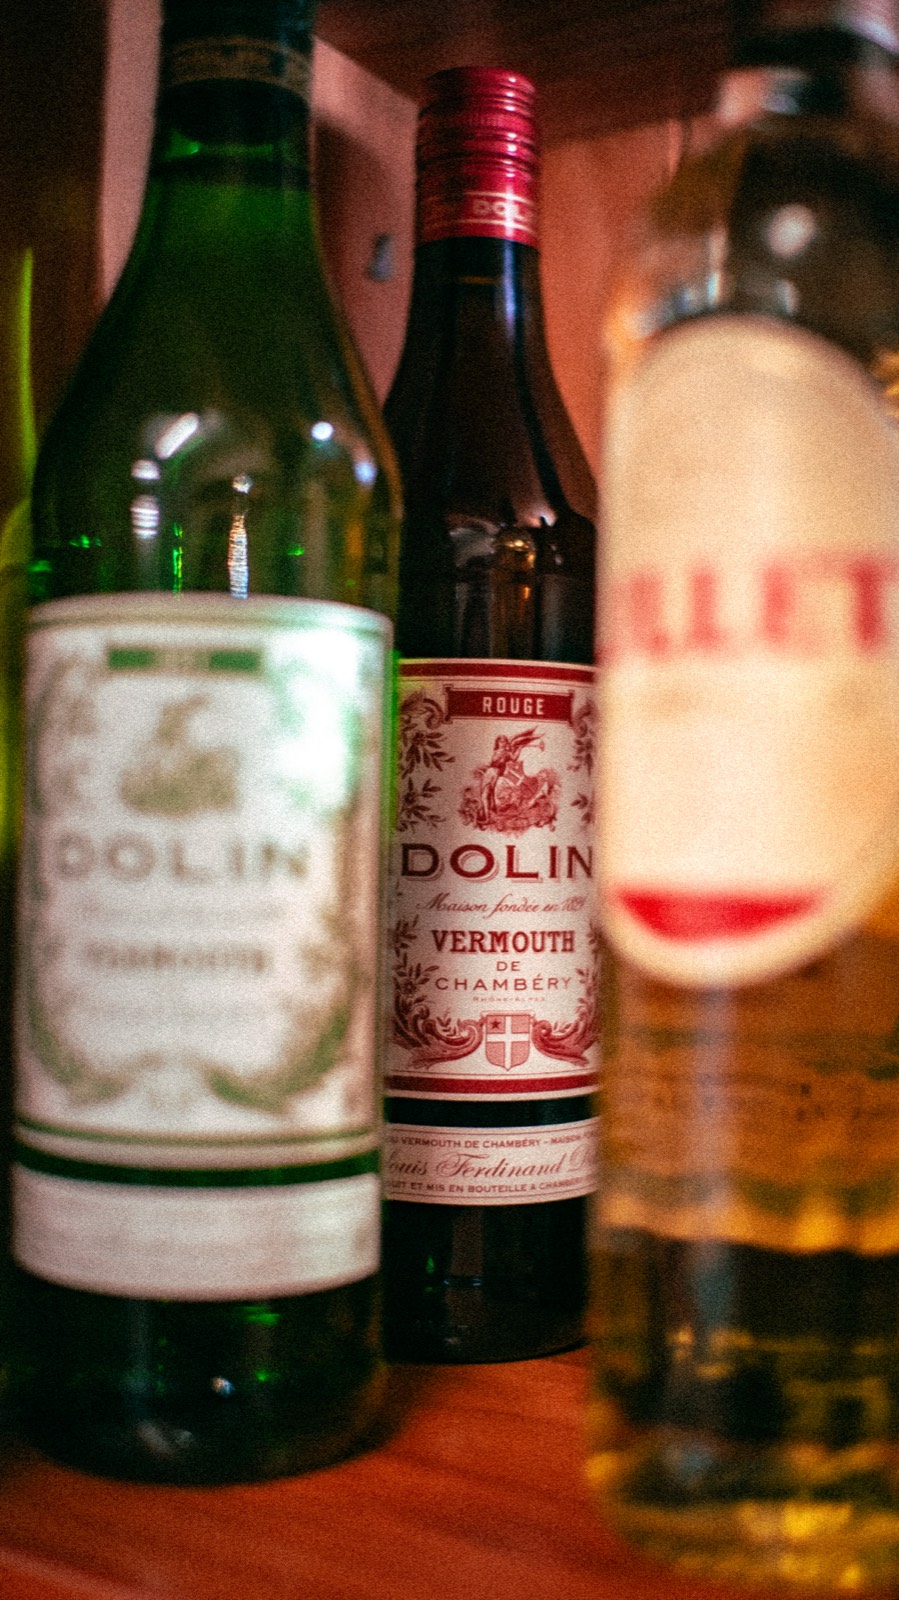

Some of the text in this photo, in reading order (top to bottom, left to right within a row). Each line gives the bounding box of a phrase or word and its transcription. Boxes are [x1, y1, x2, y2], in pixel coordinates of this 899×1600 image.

[482, 696, 545, 715] ROUGE
[401, 843, 593, 882] DOLIN
[416, 892, 488, 912] Maison
[483, 893, 538, 919] fondée
[541, 903, 558, 912] en
[431, 929, 576, 953] VERMOUTH
[496, 960, 521, 972] DE
[435, 973, 572, 991] CHAMBÉRY
[401, 1136, 461, 1148] VERMOUTH
[464, 1140, 480, 1149] DE
[435, 1151, 567, 1178] Ferdinand
[411, 1182, 424, 1190] ET
[426, 1183, 446, 1192] MIS
[449, 1184, 464, 1192] EN
[468, 1183, 527, 1193] BOUTEILLE
